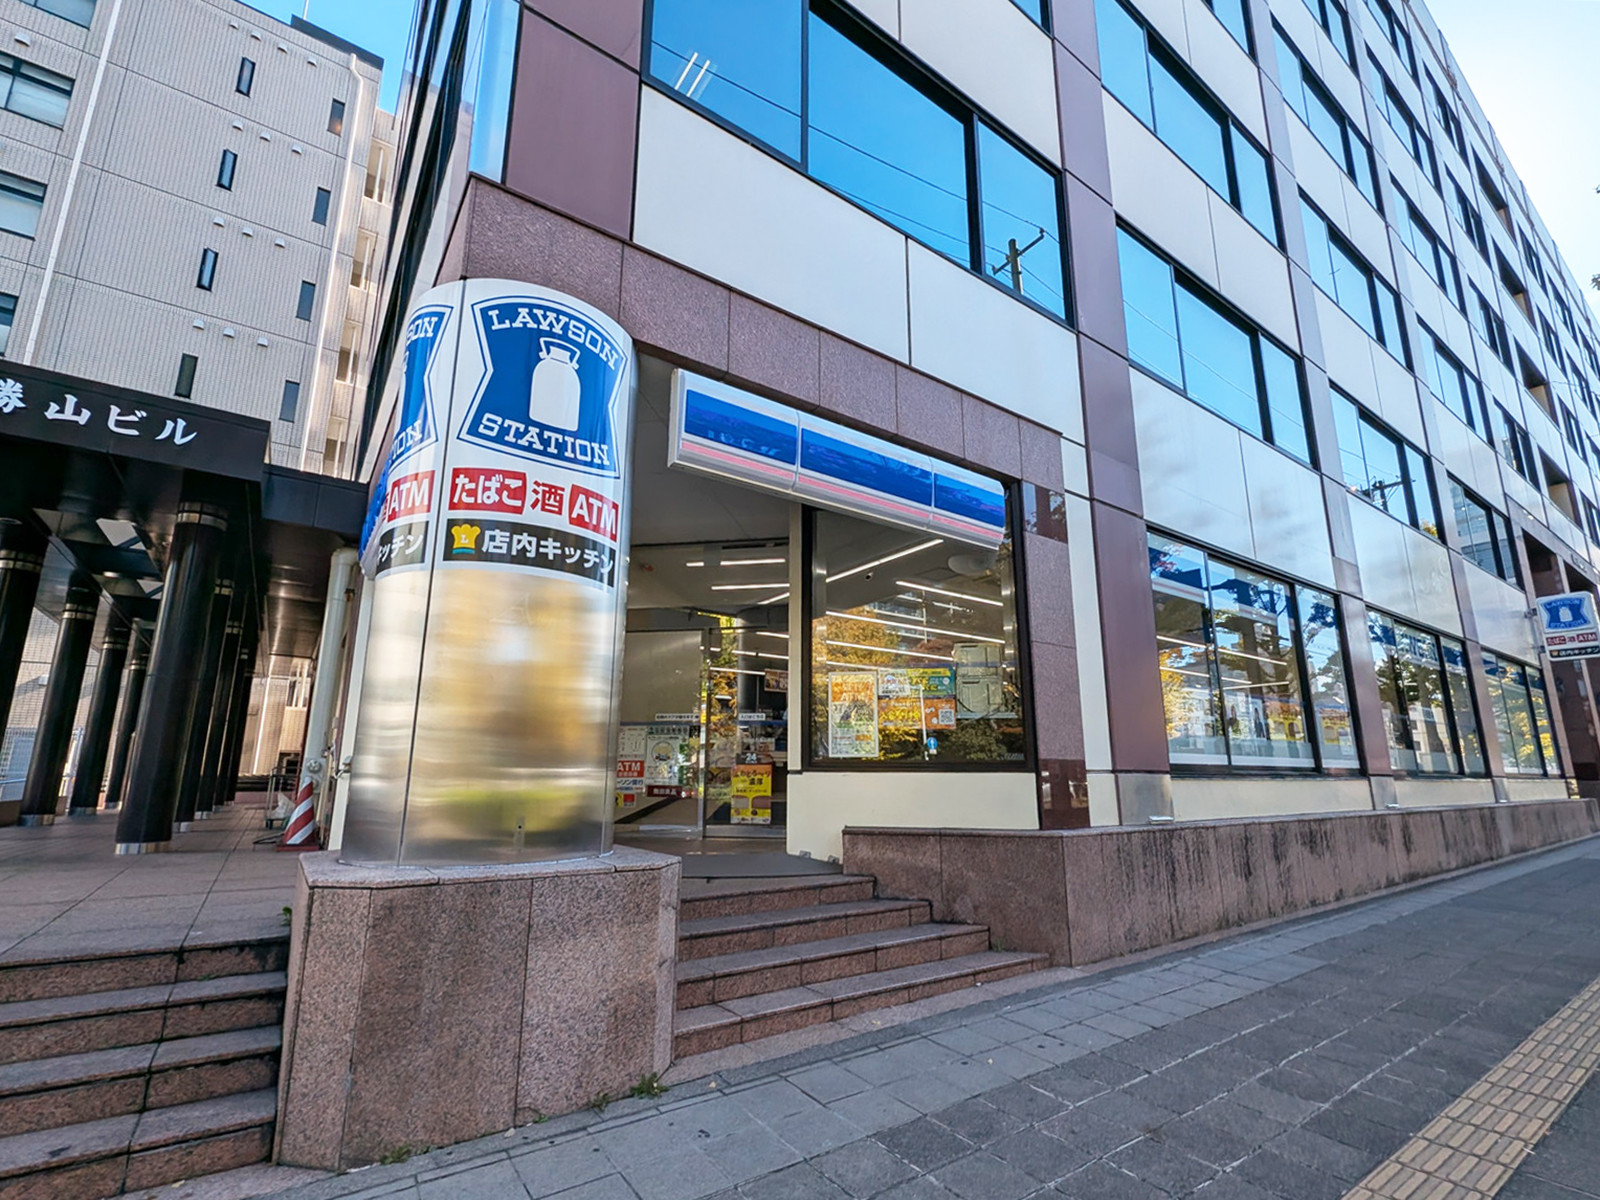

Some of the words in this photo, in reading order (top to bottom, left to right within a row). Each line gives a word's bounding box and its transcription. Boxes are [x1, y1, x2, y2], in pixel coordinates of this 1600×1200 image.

[487, 306, 620, 371] LAWSON
[477, 411, 611, 467] STATION
[389, 478, 429, 515] ATM
[453, 473, 523, 507] たばこ
[530, 480, 566, 516] 酒
[571, 493, 617, 535] ATM
[481, 529, 614, 574] 店内キッチン
[1578, 633, 1597, 642] ATM
[616, 762, 641, 772] ATM
